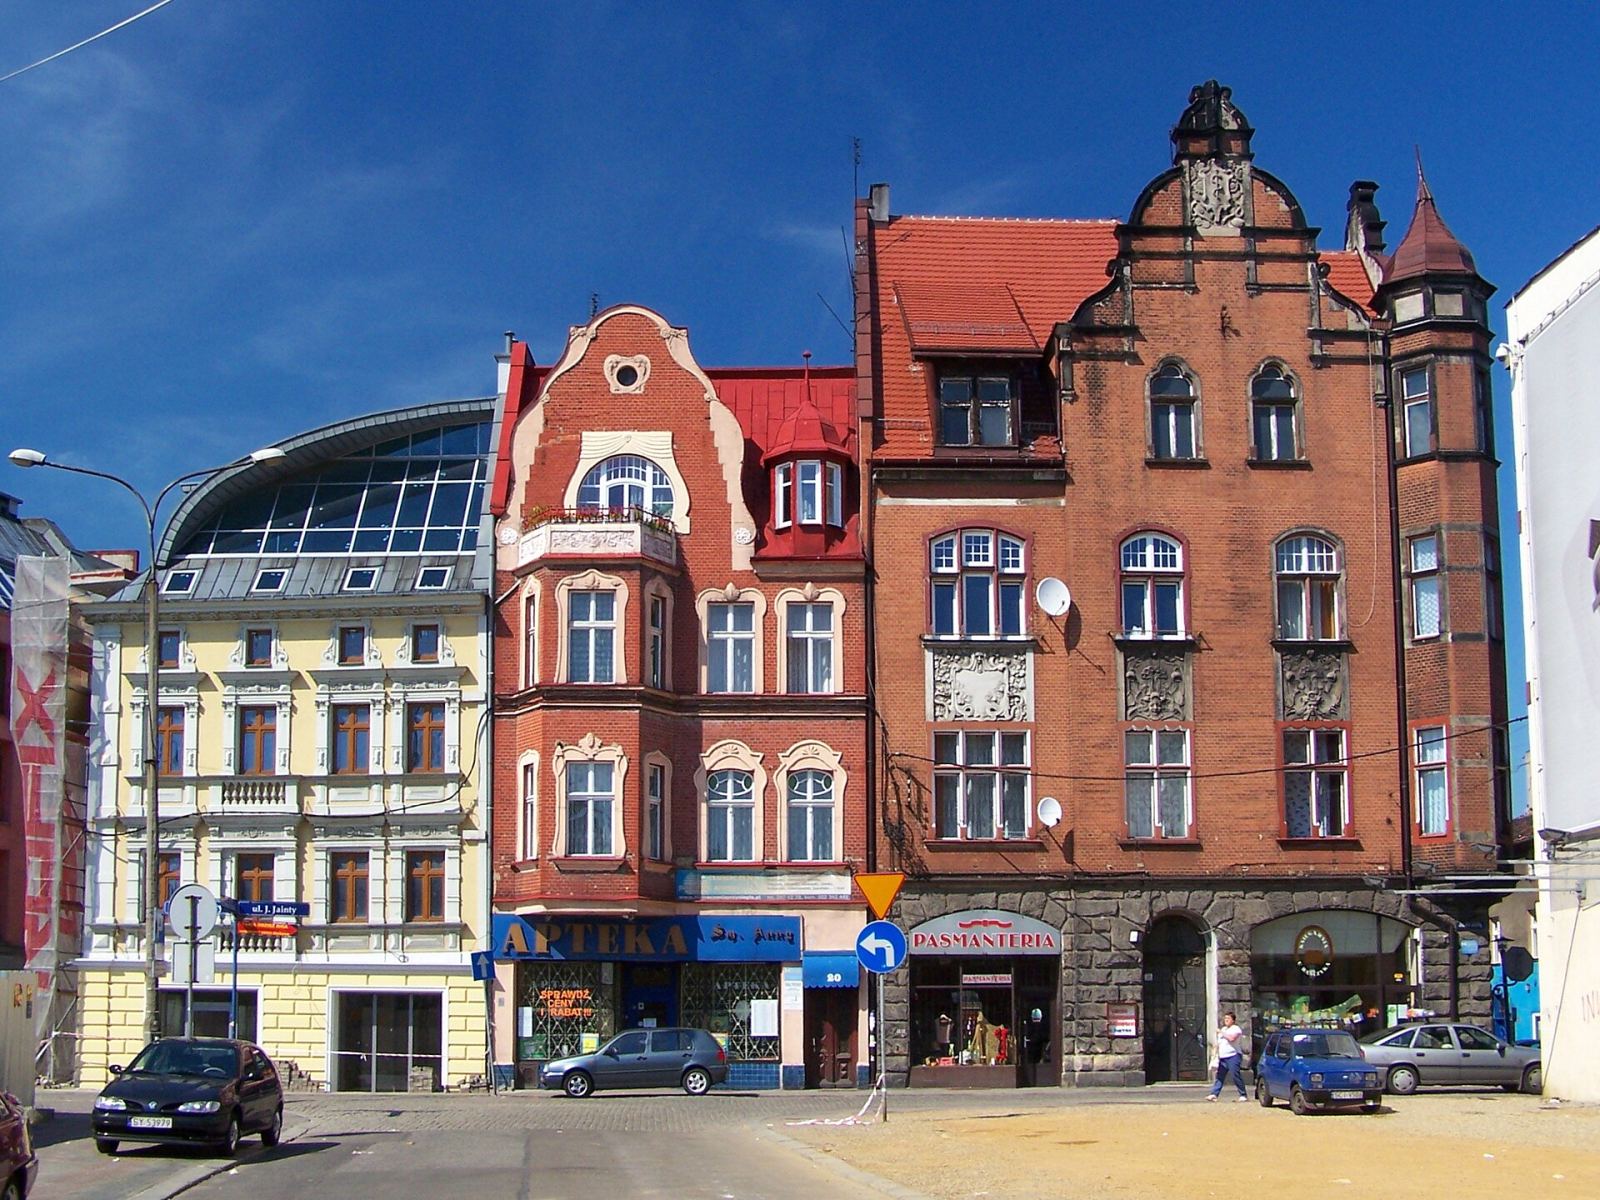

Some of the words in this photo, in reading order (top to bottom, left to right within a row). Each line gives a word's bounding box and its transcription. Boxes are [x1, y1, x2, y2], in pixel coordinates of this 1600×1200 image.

[252, 904, 263, 913] ul.
[264, 904, 271, 914] J.
[272, 903, 297, 915] Jainty
[503, 922, 689, 955] APTEKA
[754, 927, 795, 945] Anny
[913, 932, 1055, 949] PASMANTERIA
[826, 973, 842, 983] 20
[547, 999, 574, 1008] CENY
